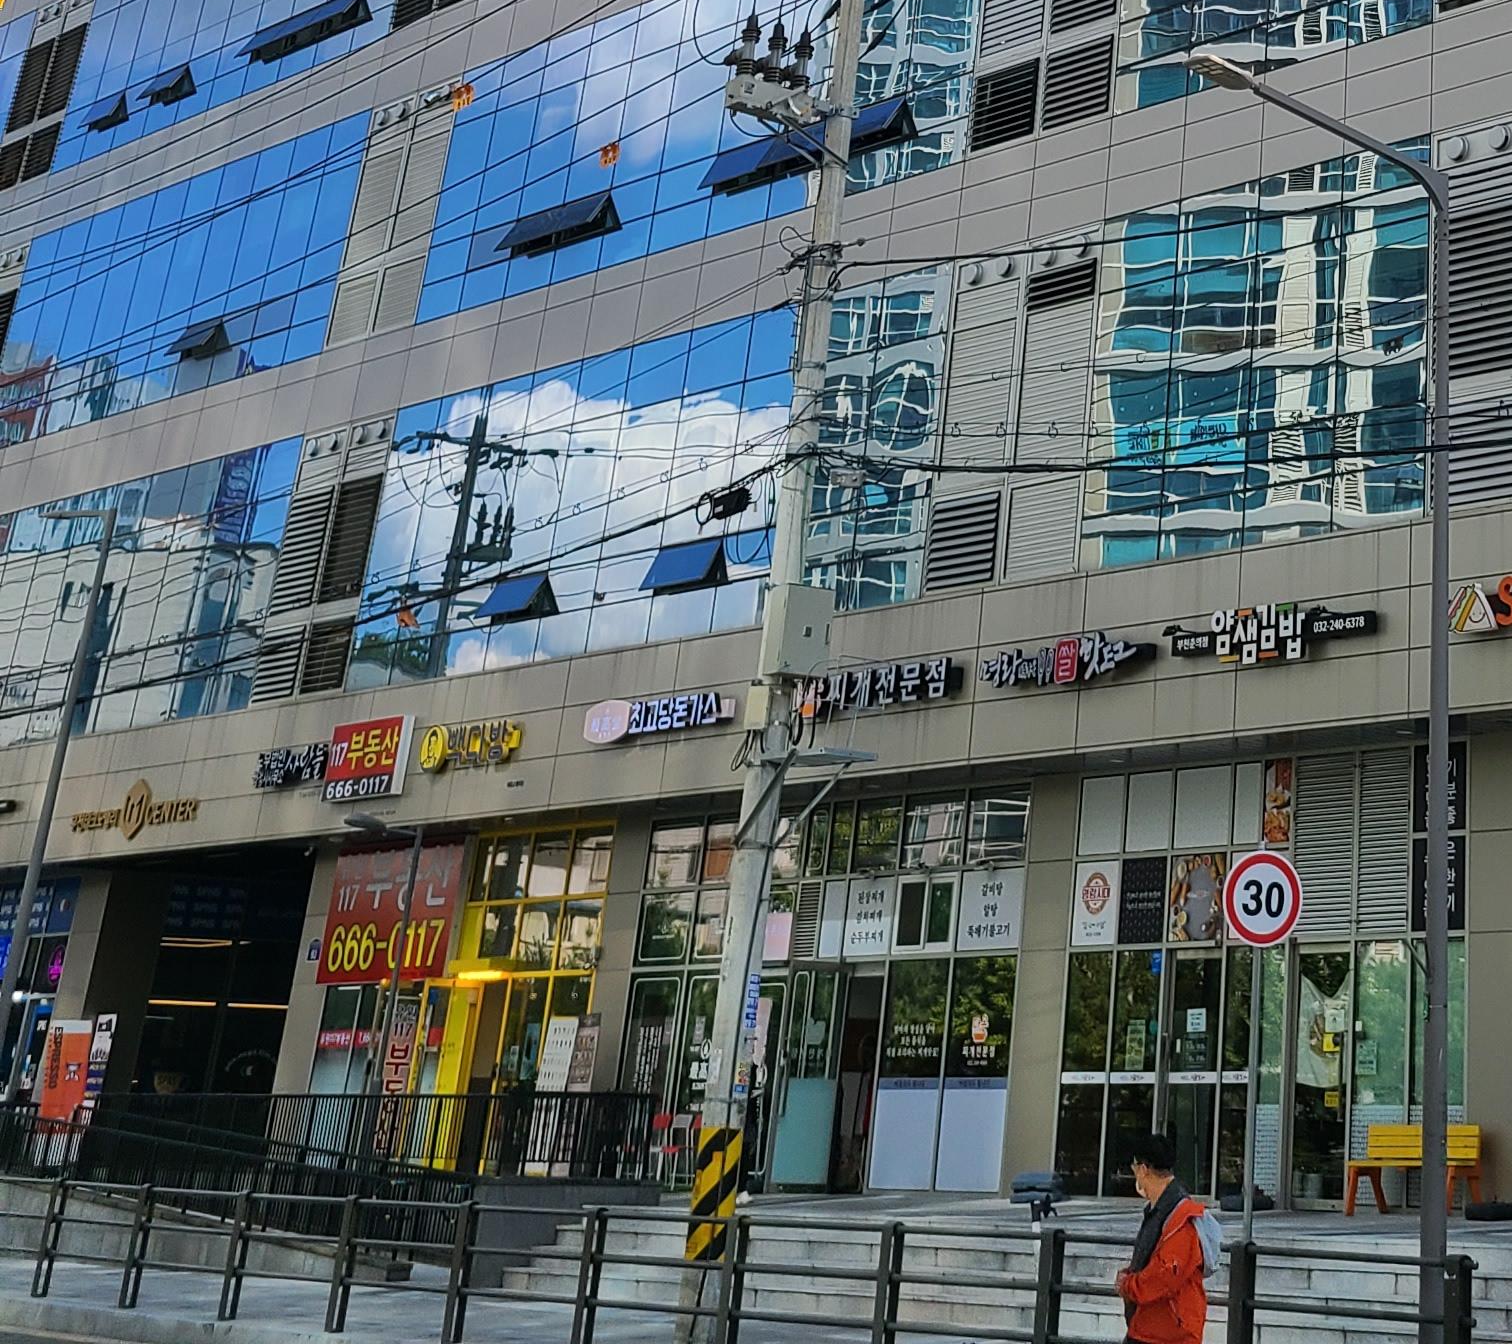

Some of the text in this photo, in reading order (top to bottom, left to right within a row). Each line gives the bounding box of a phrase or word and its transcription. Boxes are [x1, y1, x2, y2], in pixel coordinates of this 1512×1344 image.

[1210, 603, 1305, 665] 얌샘김밥
[1313, 615, 1365, 634] 032-240-6378
[827, 658, 947, 710] 찌개전문점
[628, 693, 718, 734] 최고당돈가스
[330, 725, 399, 771] 117 부동산
[446, 719, 509, 763] 빽다방
[326, 775, 390, 800] 666-0117
[148, 799, 199, 825] CENTER
[337, 883, 360, 913] 117
[1242, 879, 1285, 919] 30
[393, 1023, 413, 1038] 117
